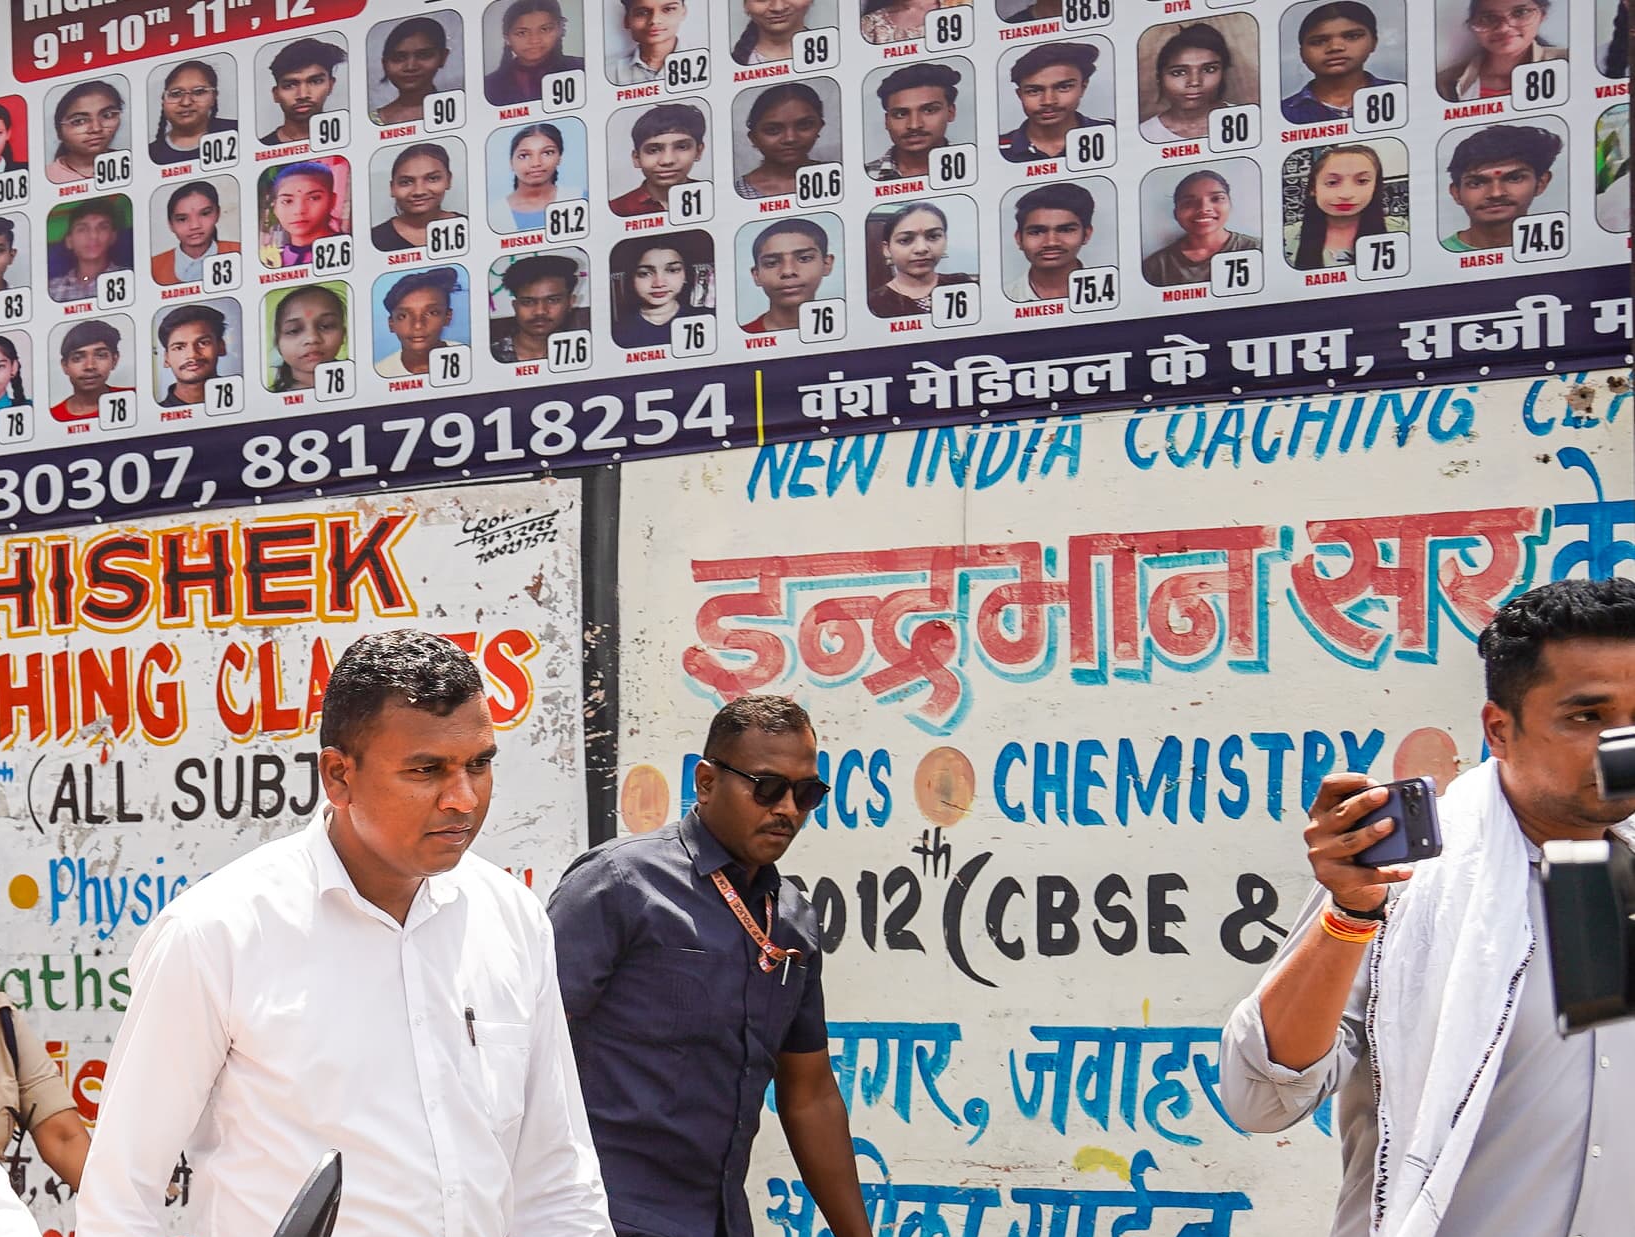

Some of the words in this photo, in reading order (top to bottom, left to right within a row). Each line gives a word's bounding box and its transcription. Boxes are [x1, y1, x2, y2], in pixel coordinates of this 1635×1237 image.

[1164, 1, 1192, 14] DIYA
[936, 13, 962, 44] 89
[804, 34, 829, 65] 89
[883, 43, 918, 59] PALAK
[668, 55, 707, 87] 89.2
[732, 63, 790, 83] AKANKSHA
[1526, 68, 1556, 100] 80
[552, 77, 575, 106] 90
[616, 85, 660, 102] PRINCE
[433, 97, 455, 126] 90
[499, 106, 529, 121] NAINA
[1366, 92, 1395, 124] 80
[1443, 102, 1504, 121] ANAMIKA
[318, 117, 341, 145] 90
[379, 125, 417, 140] KHUSHI
[1220, 113, 1249, 144] 80
[1280, 123, 1349, 144] SHIVANSHI
[202, 136, 237, 165] 90.2
[254, 143, 310, 162] DHARAMVEER
[1078, 132, 1104, 162] 80
[1161, 143, 1201, 160] SNEHA
[96, 155, 130, 185] 90.6
[161, 164, 192, 178] RAGINI
[940, 151, 966, 181] 80
[1026, 162, 1058, 178] ANSH
[58, 183, 89, 198] RUPALI
[799, 171, 841, 202] 80.6
[875, 180, 925, 198] KRISHNA
[681, 189, 702, 217] 81
[759, 199, 791, 213] NEHA
[550, 206, 585, 237] 81.2
[625, 216, 664, 232] PRITAM
[431, 224, 465, 253] 81.6
[500, 233, 543, 249] MUSKAN
[1517, 219, 1564, 255] 74.6
[315, 241, 350, 270] 82.6
[387, 251, 422, 266] SARITA
[1369, 240, 1396, 271] 75
[1459, 251, 1504, 268] HARSH
[212, 259, 233, 286] 83
[259, 268, 309, 285] VAISHNAVI
[1224, 258, 1250, 289] 75
[1305, 270, 1348, 286] RADHA
[106, 277, 126, 304] 83
[161, 284, 201, 300] RADHIKA
[1073, 273, 1115, 305] 75.4
[1162, 286, 1207, 303] MOHINI
[4, 294, 23, 319] 83
[64, 302, 92, 315] NAITIK
[944, 290, 967, 319] 76
[1014, 302, 1064, 319] ANIKESH
[811, 306, 833, 335] 76
[889, 319, 923, 333] KAJAL
[683, 322, 705, 350] 76
[745, 335, 777, 349] VIVEK
[553, 337, 587, 365] 77.6
[625, 349, 667, 364] ANCHAL
[798, 370, 892, 421] वंश
[906, 350, 1133, 410] मेडिकल
[1146, 334, 1211, 385] के
[1399, 294, 1572, 361] सब्जी
[440, 353, 460, 379] 78
[515, 364, 540, 377] NEEV
[325, 367, 345, 394] 78
[388, 379, 423, 393] PAWAN
[214, 383, 234, 409] 78
[109, 398, 127, 423] 78
[160, 408, 193, 422] PRINCE
[7, 412, 24, 437] 78
[241, 382, 735, 489] 8817918254
[746, 432, 888, 503] NEW
[906, 414, 1083, 491] INDIA
[1124, 385, 1479, 470] COACHING
[171, 752, 320, 822] SUBJ
[993, 729, 1385, 828] CHEMISTRY
[48, 856, 213, 941] Physi
